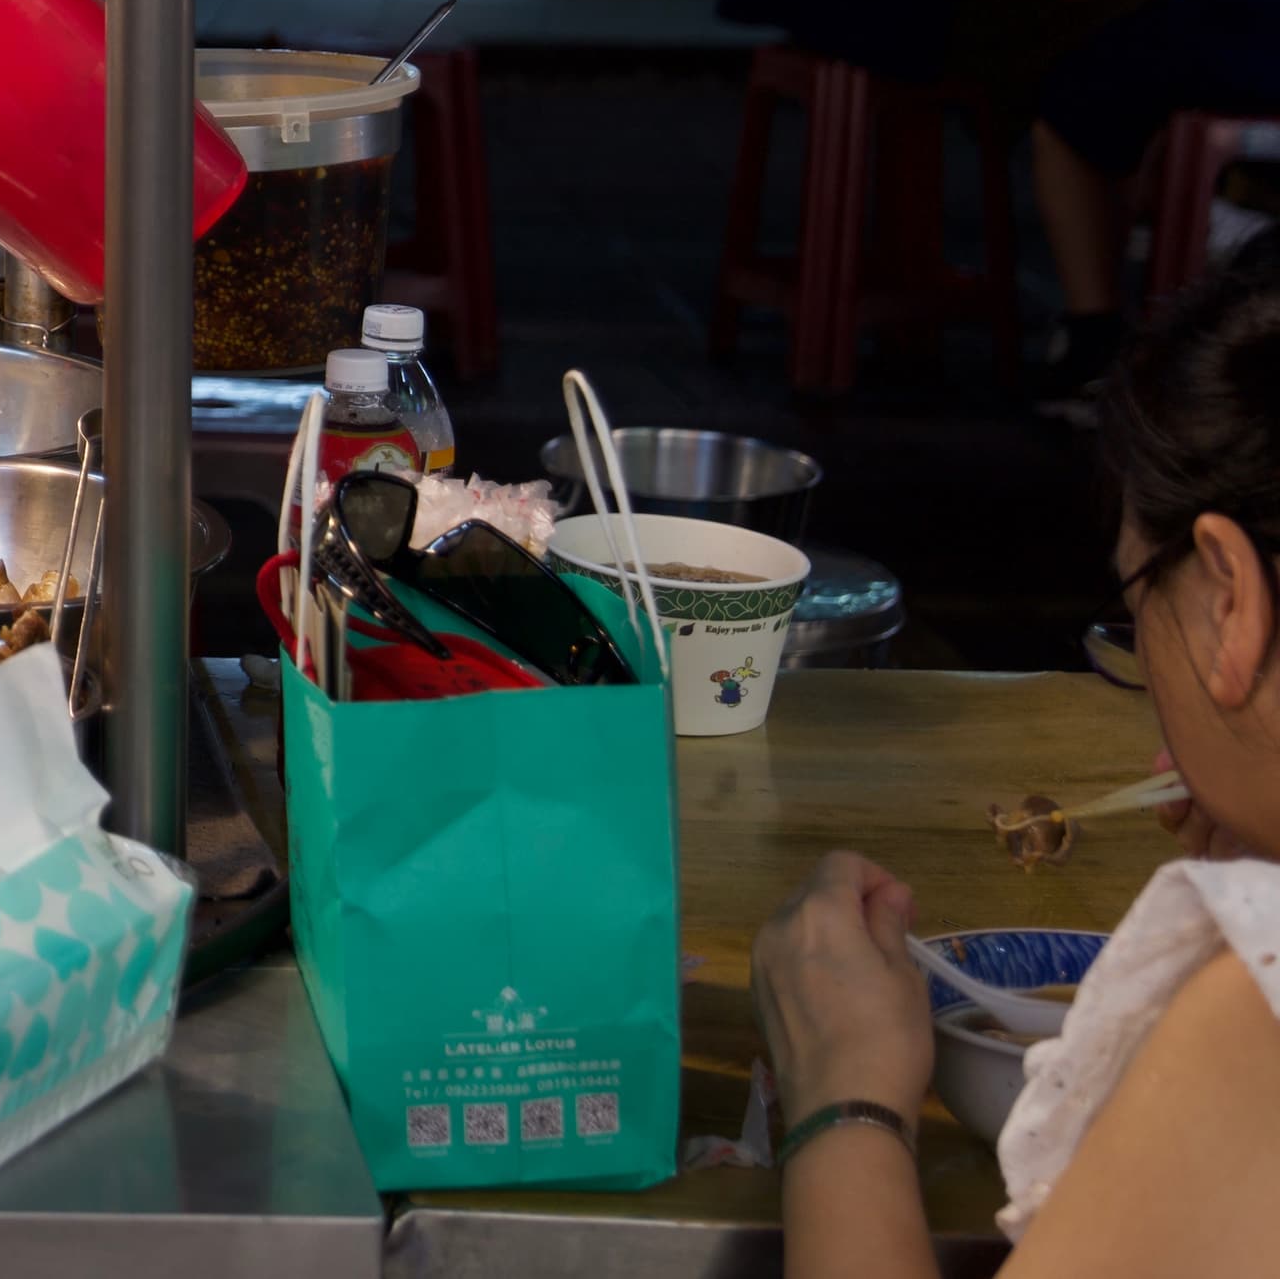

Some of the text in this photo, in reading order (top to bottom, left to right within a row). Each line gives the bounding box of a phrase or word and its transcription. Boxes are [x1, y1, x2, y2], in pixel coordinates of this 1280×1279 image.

[705, 625, 730, 635] Enjoy
[732, 626, 750, 635] your
[525, 1037, 577, 1051] LOTUS
